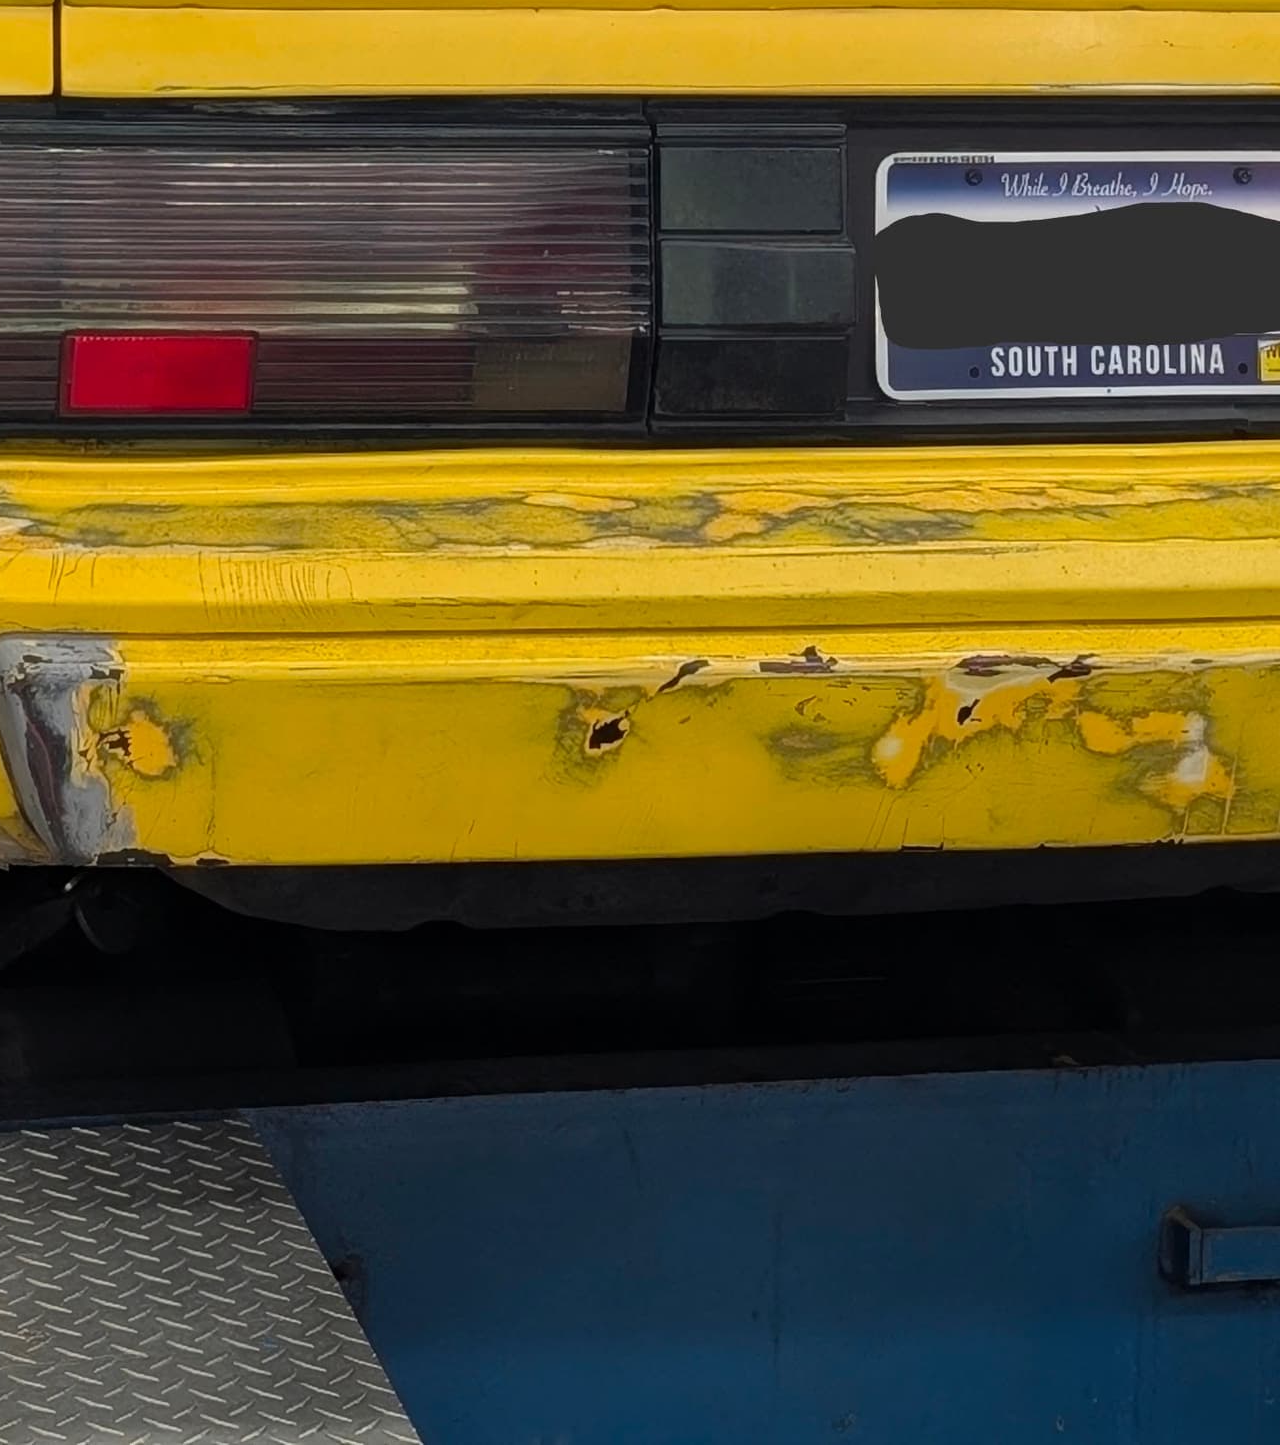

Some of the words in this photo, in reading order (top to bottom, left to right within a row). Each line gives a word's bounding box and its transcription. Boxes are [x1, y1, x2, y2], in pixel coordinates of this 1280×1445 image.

[1001, 172, 1049, 196] While
[1051, 172, 1068, 197] I
[1071, 171, 1137, 197] Breathe,
[1142, 172, 1159, 197] I
[1161, 172, 1213, 201] Hope.
[991, 346, 1078, 377] SOUTH
[1090, 344, 1225, 375] CAROLINA
